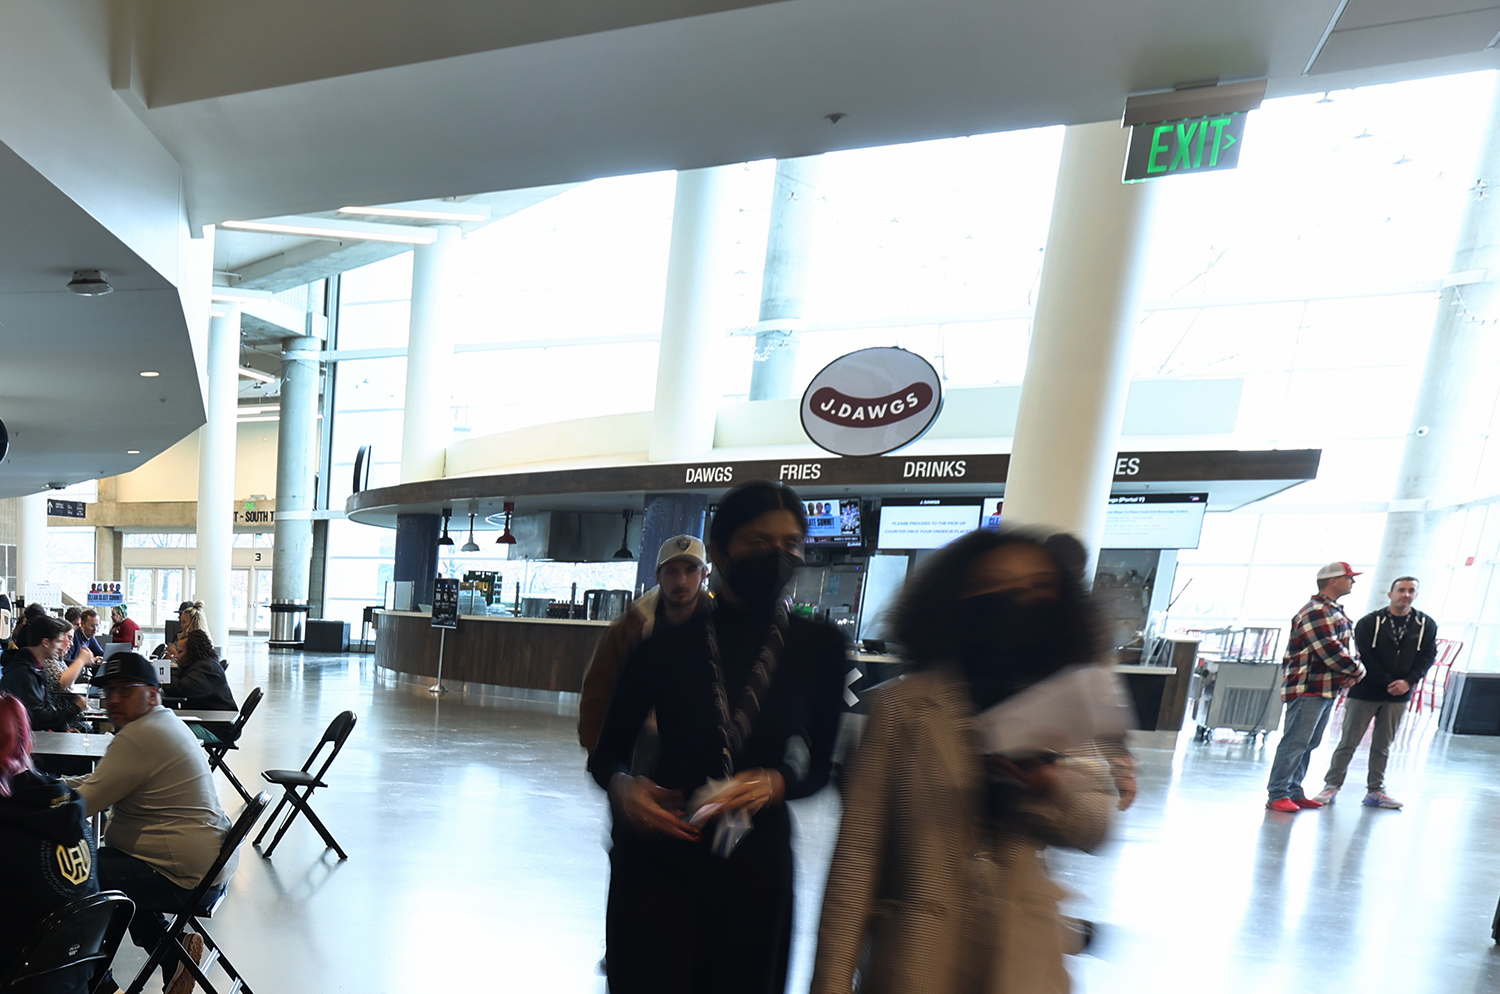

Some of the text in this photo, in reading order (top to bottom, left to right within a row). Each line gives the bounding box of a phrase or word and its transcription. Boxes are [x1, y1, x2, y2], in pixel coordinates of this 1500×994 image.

[1146, 117, 1232, 173] EXIT
[820, 392, 919, 421] J.DAWGS
[685, 458, 1140, 483] DAWGS FRIES DRINKS ES
[245, 511, 268, 522] SOUTH
[255, 552, 262, 562] 3
